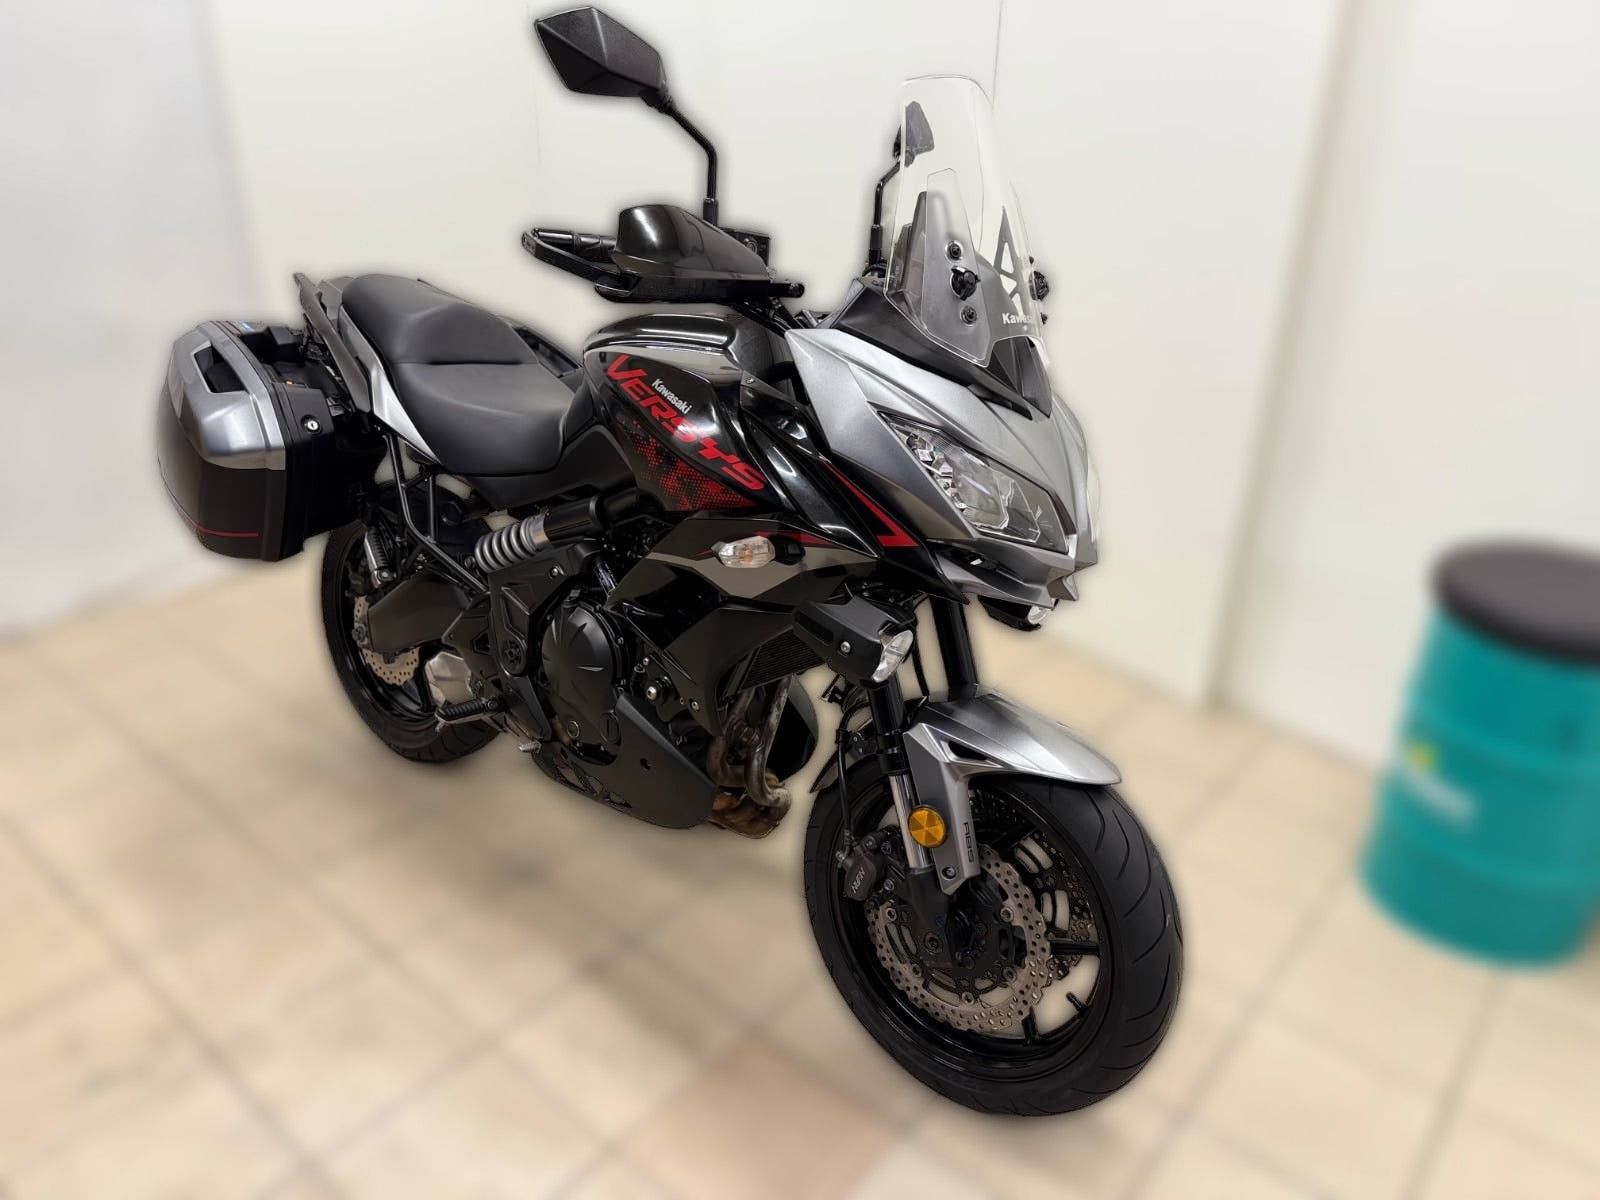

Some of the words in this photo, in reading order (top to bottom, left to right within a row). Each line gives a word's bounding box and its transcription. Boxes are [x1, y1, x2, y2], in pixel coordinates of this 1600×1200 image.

[651, 378, 692, 415] Kawasaki
[606, 353, 768, 491] VERSYS
[963, 822, 975, 863] ABS
